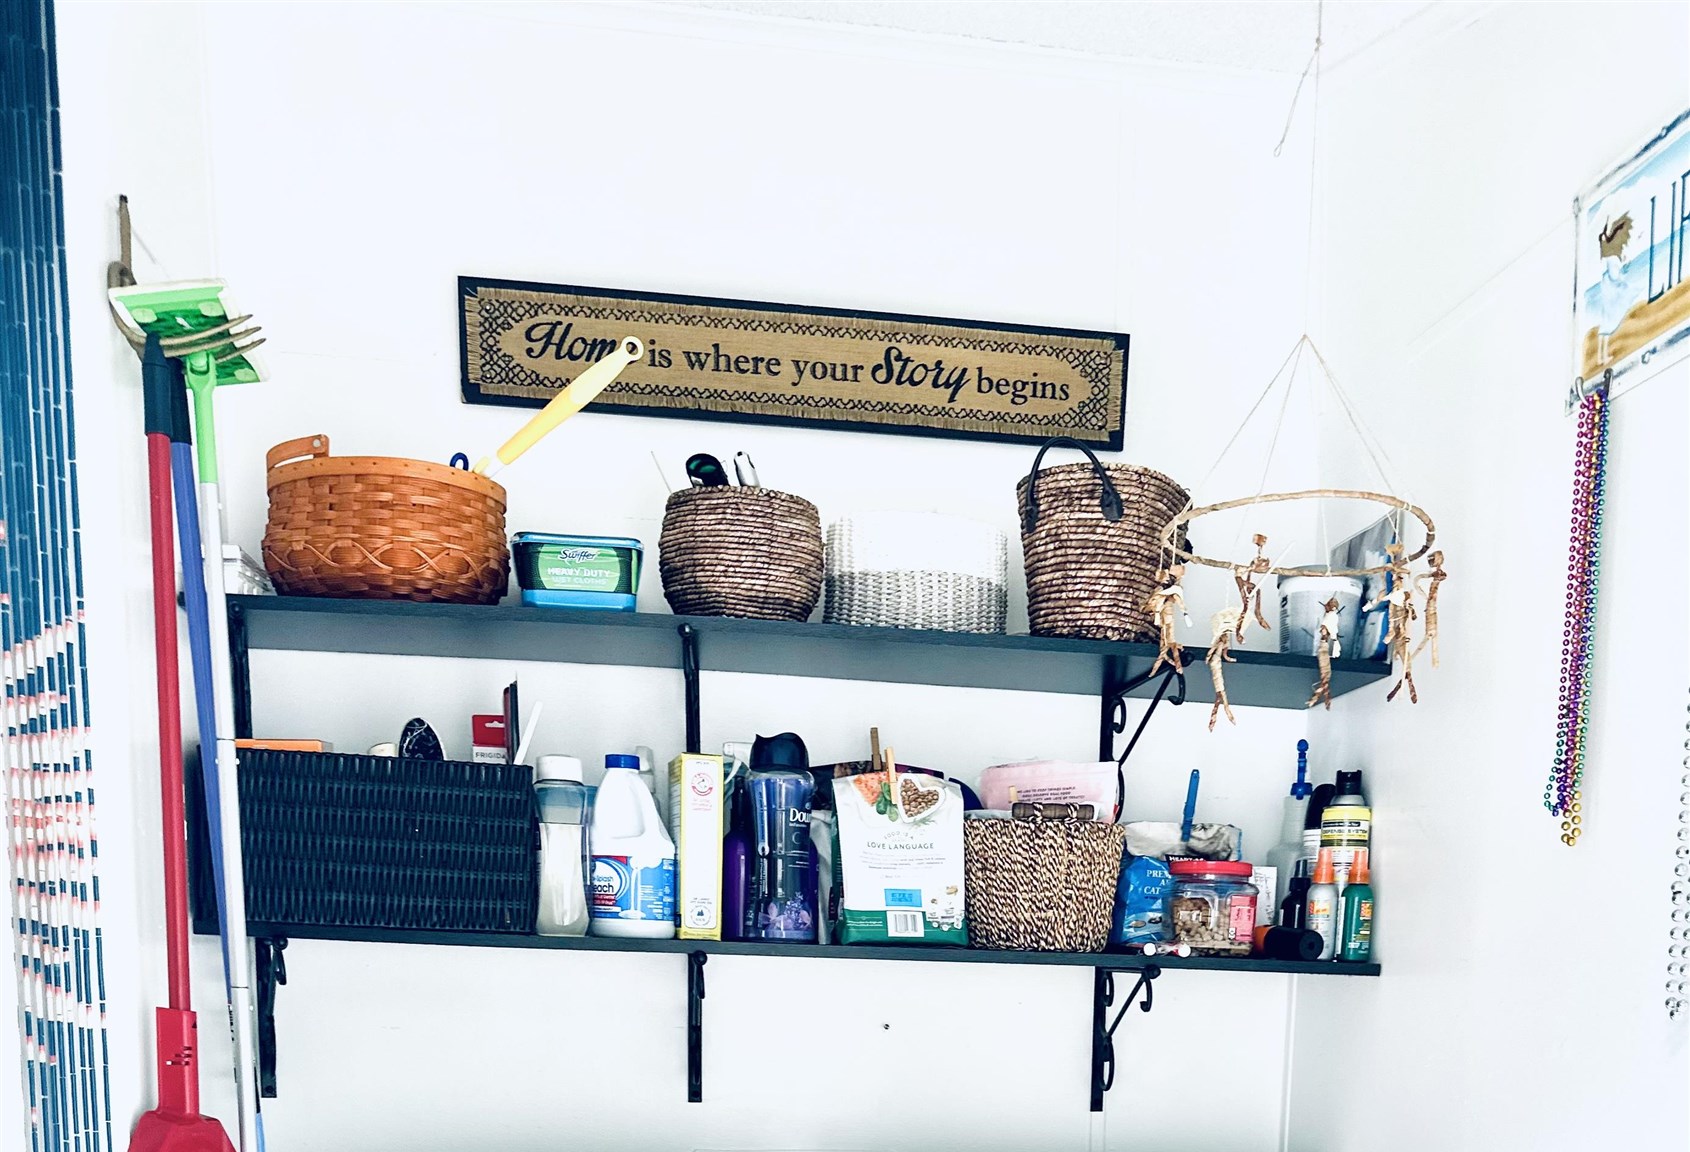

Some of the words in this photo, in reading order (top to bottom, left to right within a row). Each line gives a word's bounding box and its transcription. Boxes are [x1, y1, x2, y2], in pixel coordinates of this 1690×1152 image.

[525, 320, 637, 365] Hom
[648, 338, 672, 368] is
[682, 343, 781, 376] where
[791, 359, 864, 387] your
[871, 346, 971, 403] Story
[976, 366, 1070, 406] begins
[560, 549, 597, 562] Swiffer
[547, 567, 581, 577] HEAVY
[583, 568, 611, 577] DUTY
[867, 841, 886, 849] LOVE
[1144, 886, 1161, 895] CAT
